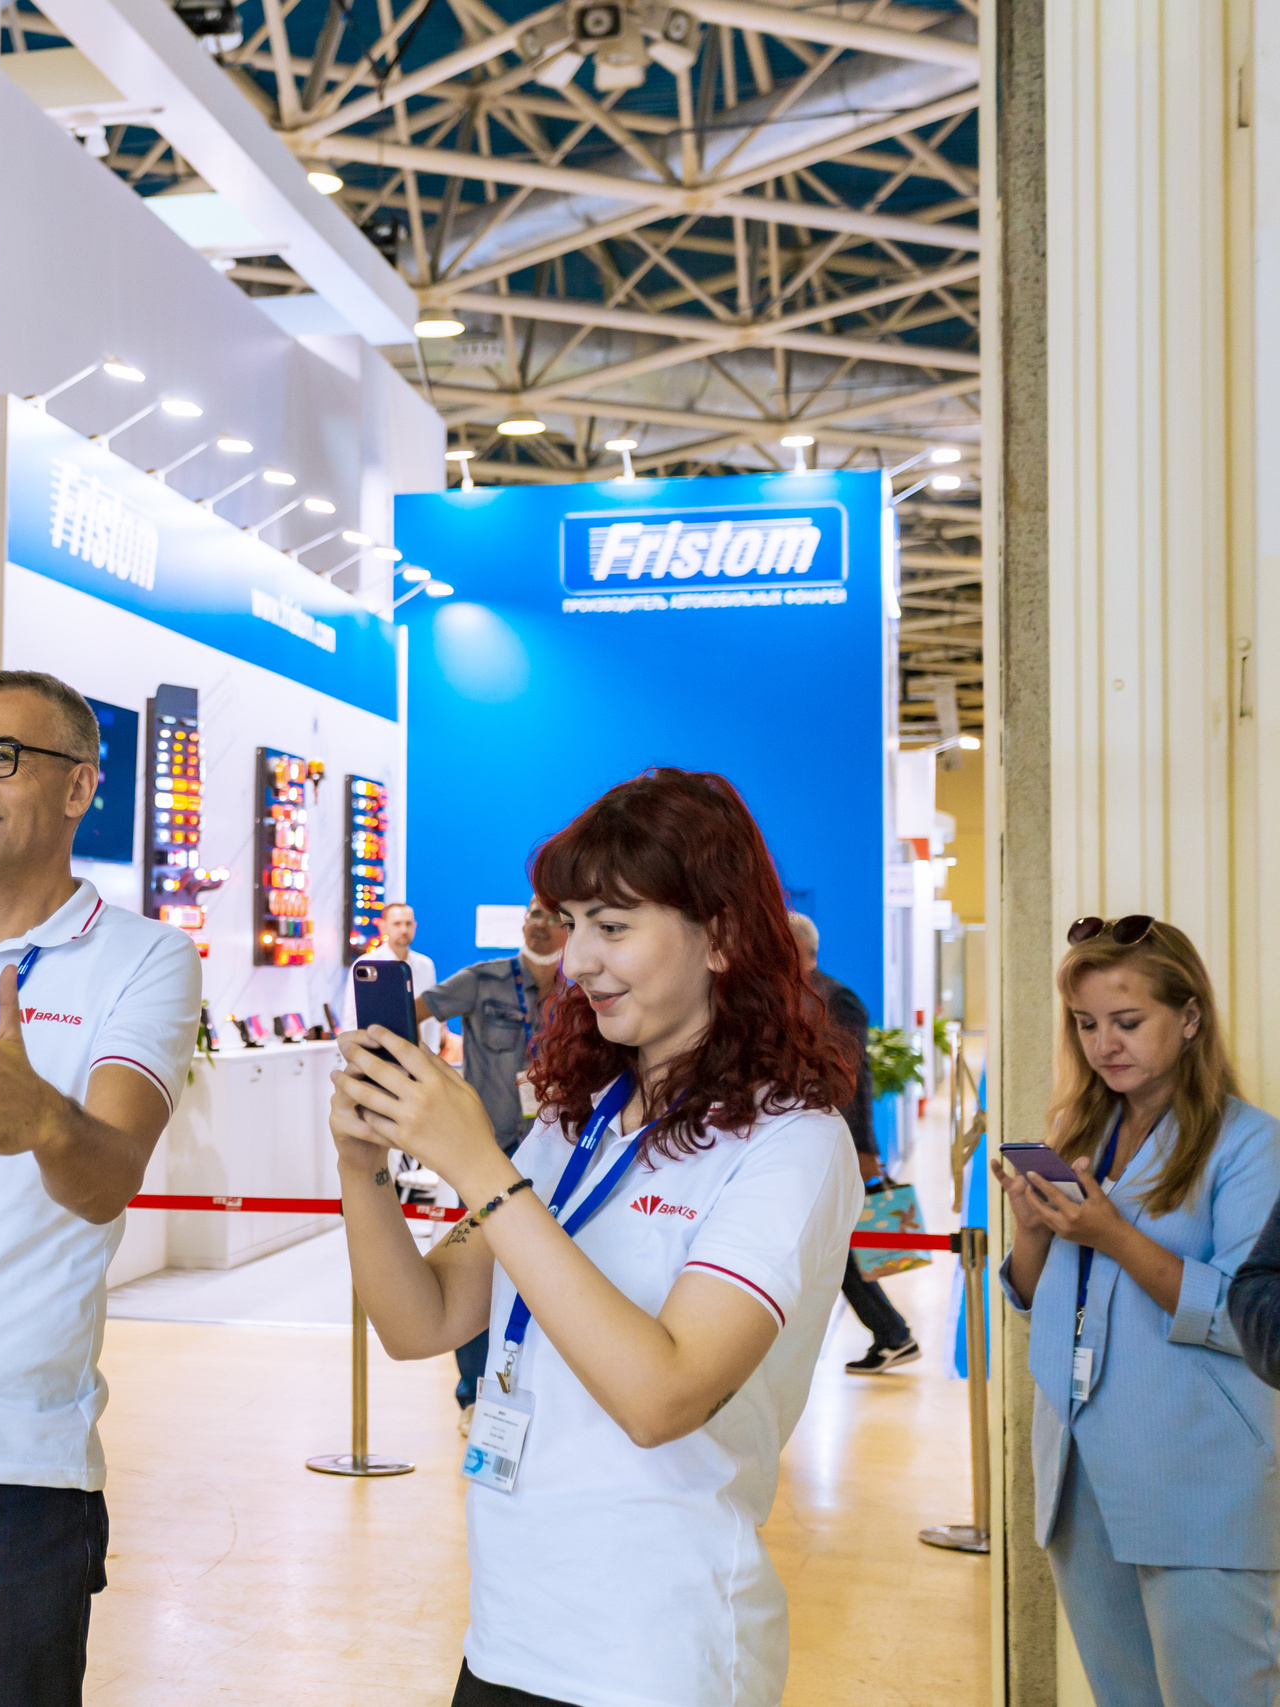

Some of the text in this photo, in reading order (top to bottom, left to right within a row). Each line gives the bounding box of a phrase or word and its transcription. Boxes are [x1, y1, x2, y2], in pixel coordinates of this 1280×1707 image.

[51, 459, 159, 591] Fristom
[590, 518, 821, 581] Fristom
[34, 1012, 83, 1026] BRAXIS
